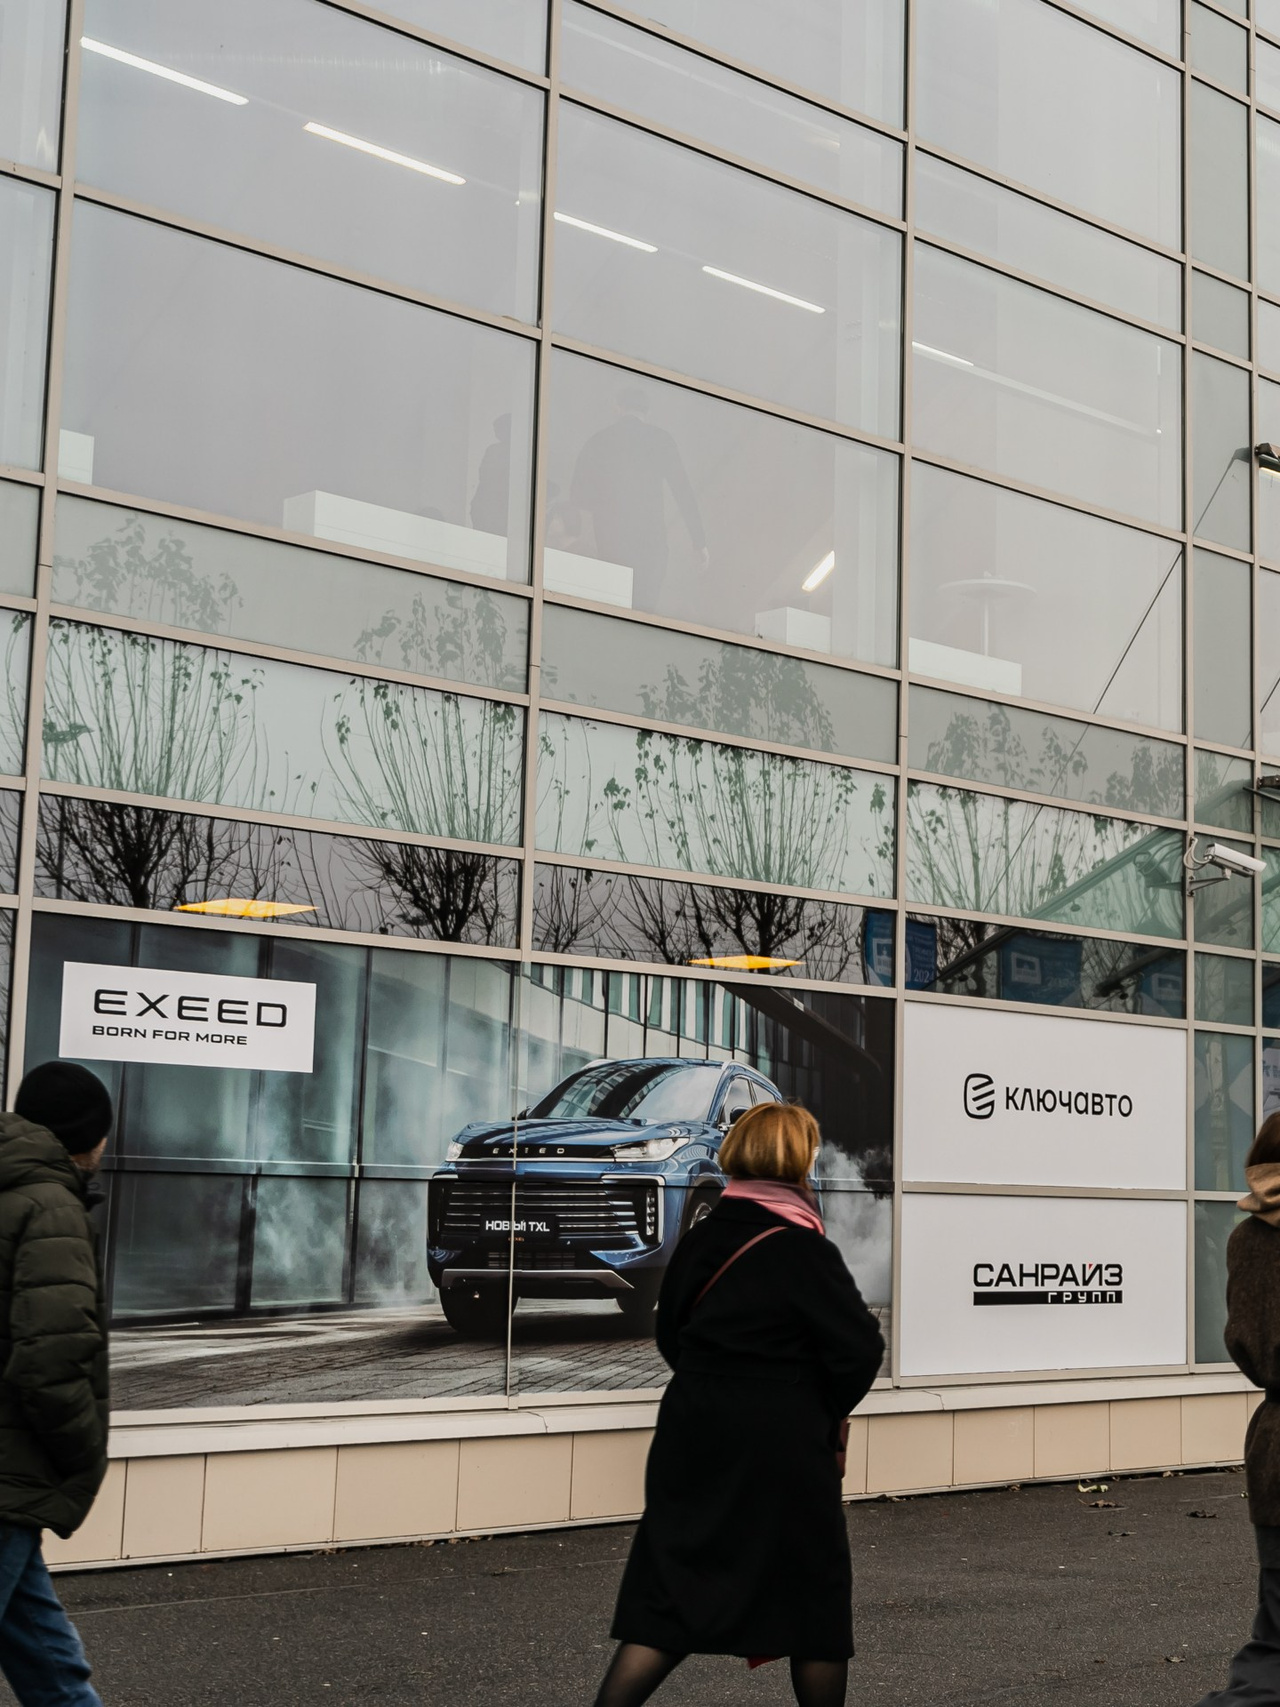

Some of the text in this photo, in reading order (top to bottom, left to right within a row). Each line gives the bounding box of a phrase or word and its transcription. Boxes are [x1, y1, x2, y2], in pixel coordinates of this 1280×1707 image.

[93, 988, 288, 1028] EXEED
[92, 1025, 248, 1045] BORN FOR MORE
[528, 1221, 551, 1232] TXL
[973, 1263, 1123, 1287] САНРАЙЗ
[1047, 1291, 1117, 1304] ГРУПП
